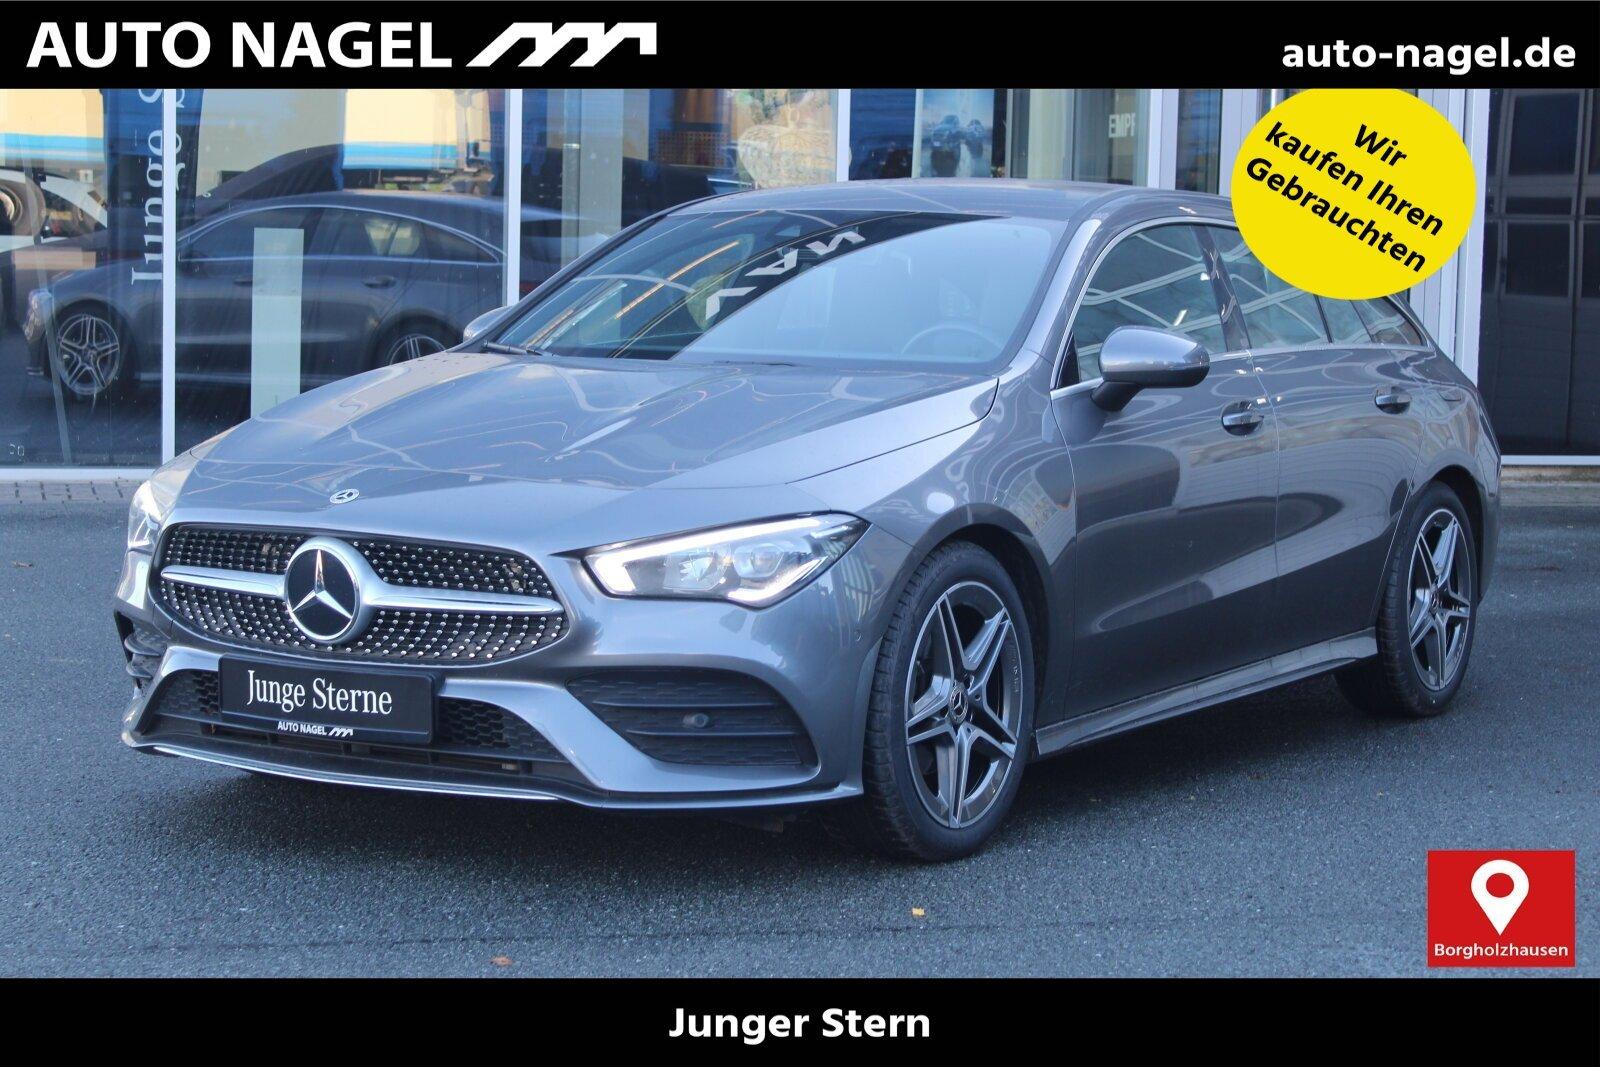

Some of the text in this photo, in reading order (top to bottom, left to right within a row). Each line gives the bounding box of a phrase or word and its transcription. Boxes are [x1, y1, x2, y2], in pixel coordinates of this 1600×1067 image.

[246, 669, 393, 715] Junge Sterne
[277, 721, 327, 736] AUTO NAGEL
